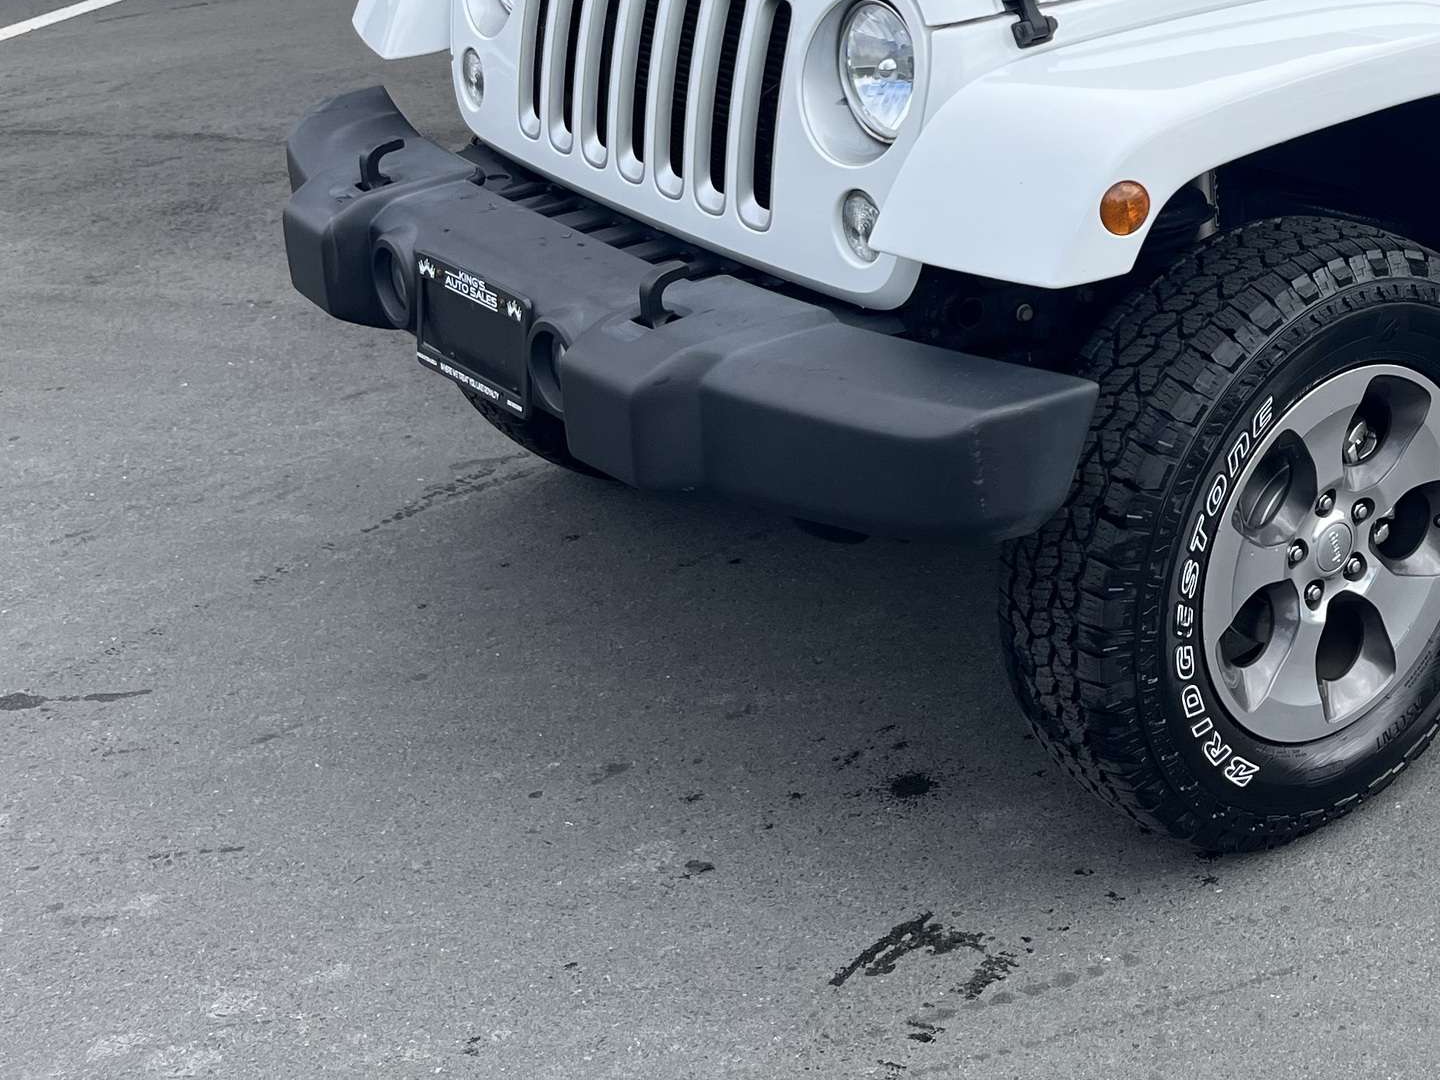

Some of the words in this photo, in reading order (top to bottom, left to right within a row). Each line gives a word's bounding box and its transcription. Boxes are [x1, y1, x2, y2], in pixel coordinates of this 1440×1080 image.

[445, 275, 468, 294] AUTO
[470, 286, 497, 307] SALES
[1176, 396, 1273, 787] BRIDGESTONE
